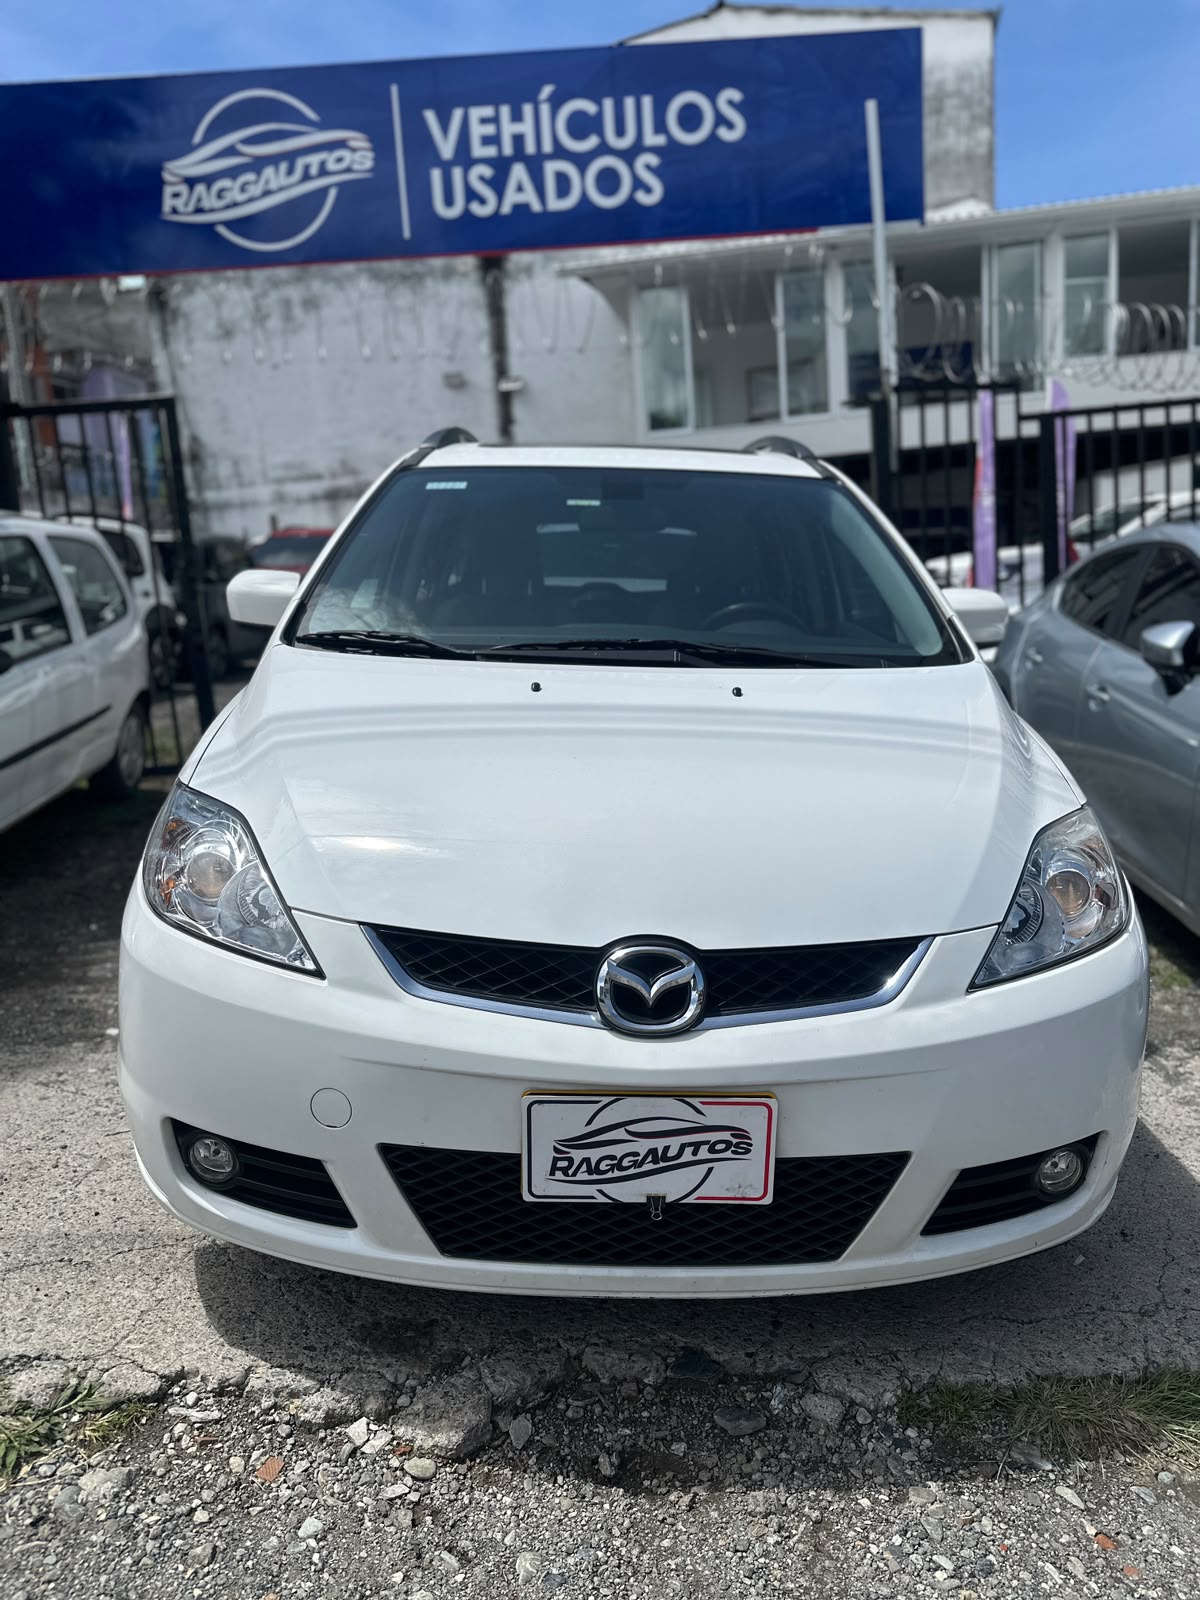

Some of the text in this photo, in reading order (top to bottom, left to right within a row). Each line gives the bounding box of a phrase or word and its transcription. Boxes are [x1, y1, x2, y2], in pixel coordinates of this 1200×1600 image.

[422, 84, 747, 161] VEHÍCULOS
[162, 149, 375, 214] RAGGAUTOS
[430, 152, 665, 220] USADOS
[549, 1139, 754, 1177] RAGGAUTOS
